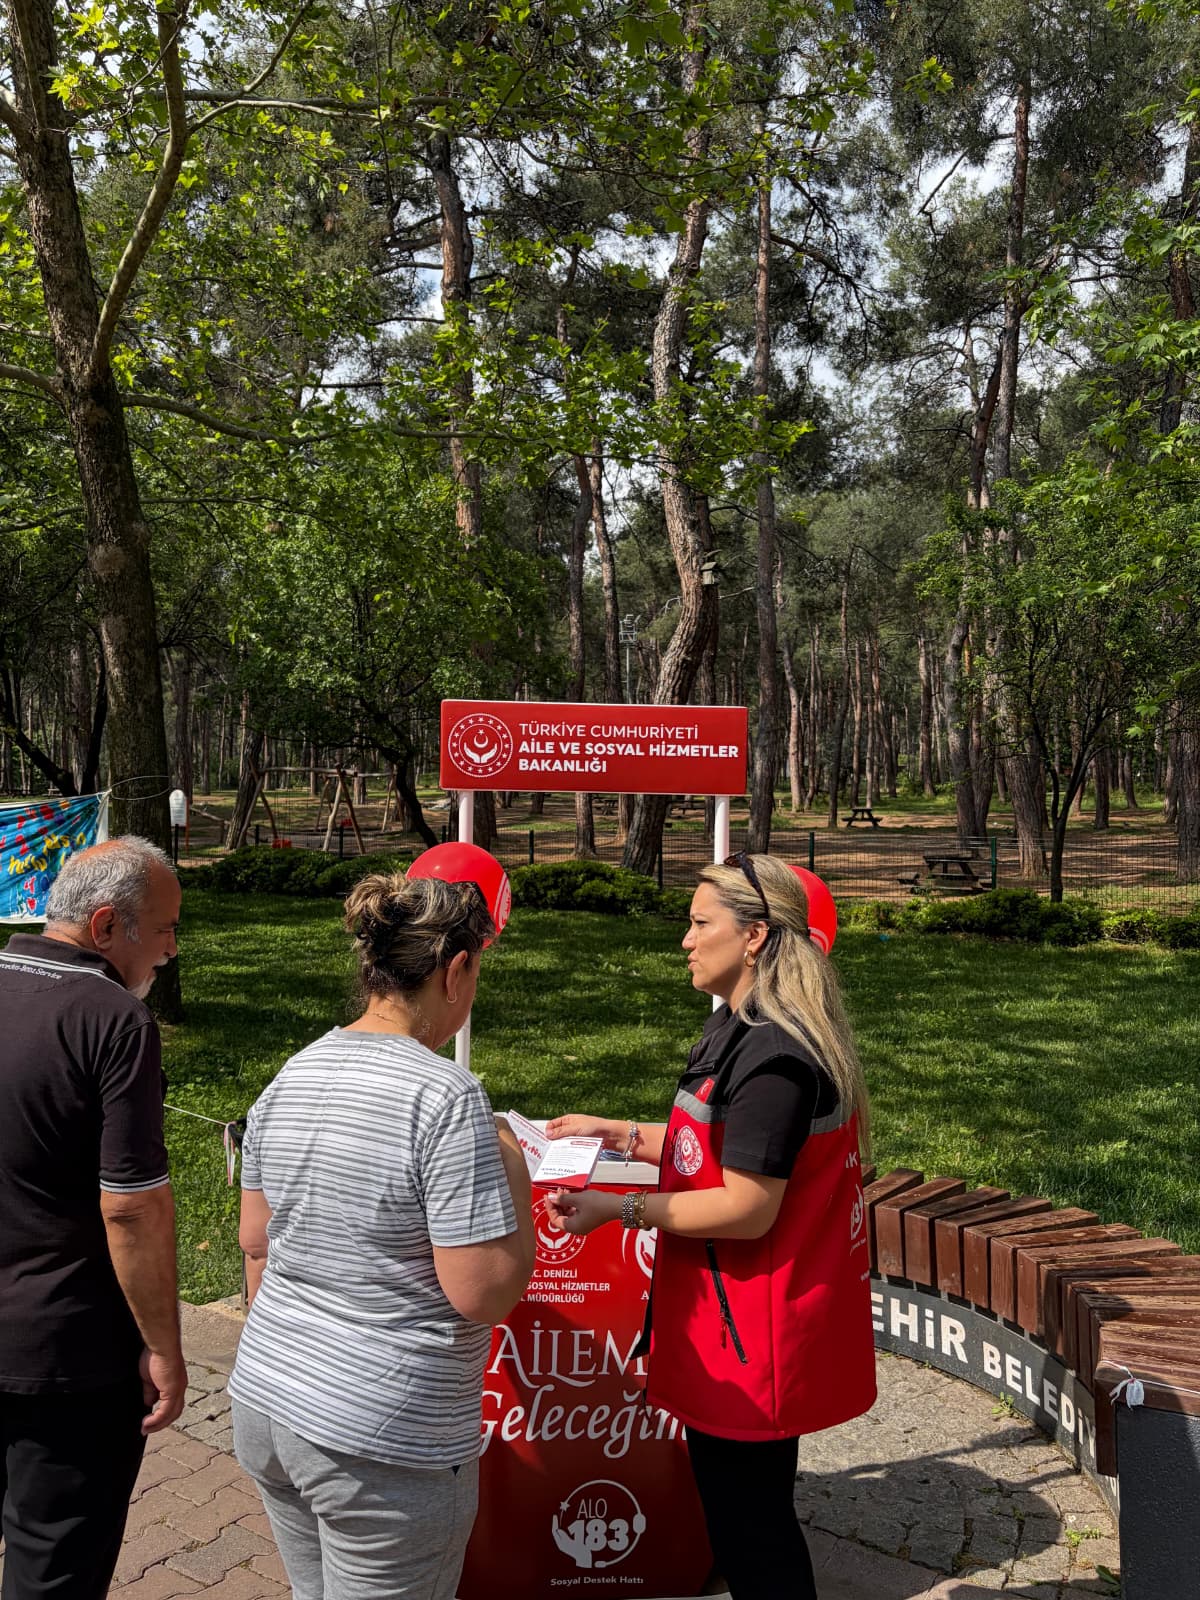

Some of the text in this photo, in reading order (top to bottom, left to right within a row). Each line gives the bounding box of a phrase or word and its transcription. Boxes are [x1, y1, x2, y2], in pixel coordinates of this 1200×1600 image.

[518, 720, 699, 740] TÜRKİYE CUMHURİYETİ
[518, 738, 739, 758] AİLE VE SOSYAL HİZMETLER
[518, 756, 607, 774] BAKANLIĞI
[543, 1267, 578, 1279] DENİZLİ
[527, 1280, 610, 1292] SOSYAL HİZMETLER
[527, 1292, 585, 1304] MÜDÜRLÜĞÜ
[486, 1320, 649, 1389] AİLEM
[576, 1497, 608, 1519] ALO
[567, 1518, 630, 1552] 183
[550, 1575, 644, 1587] Sosyal Destek Hattı
